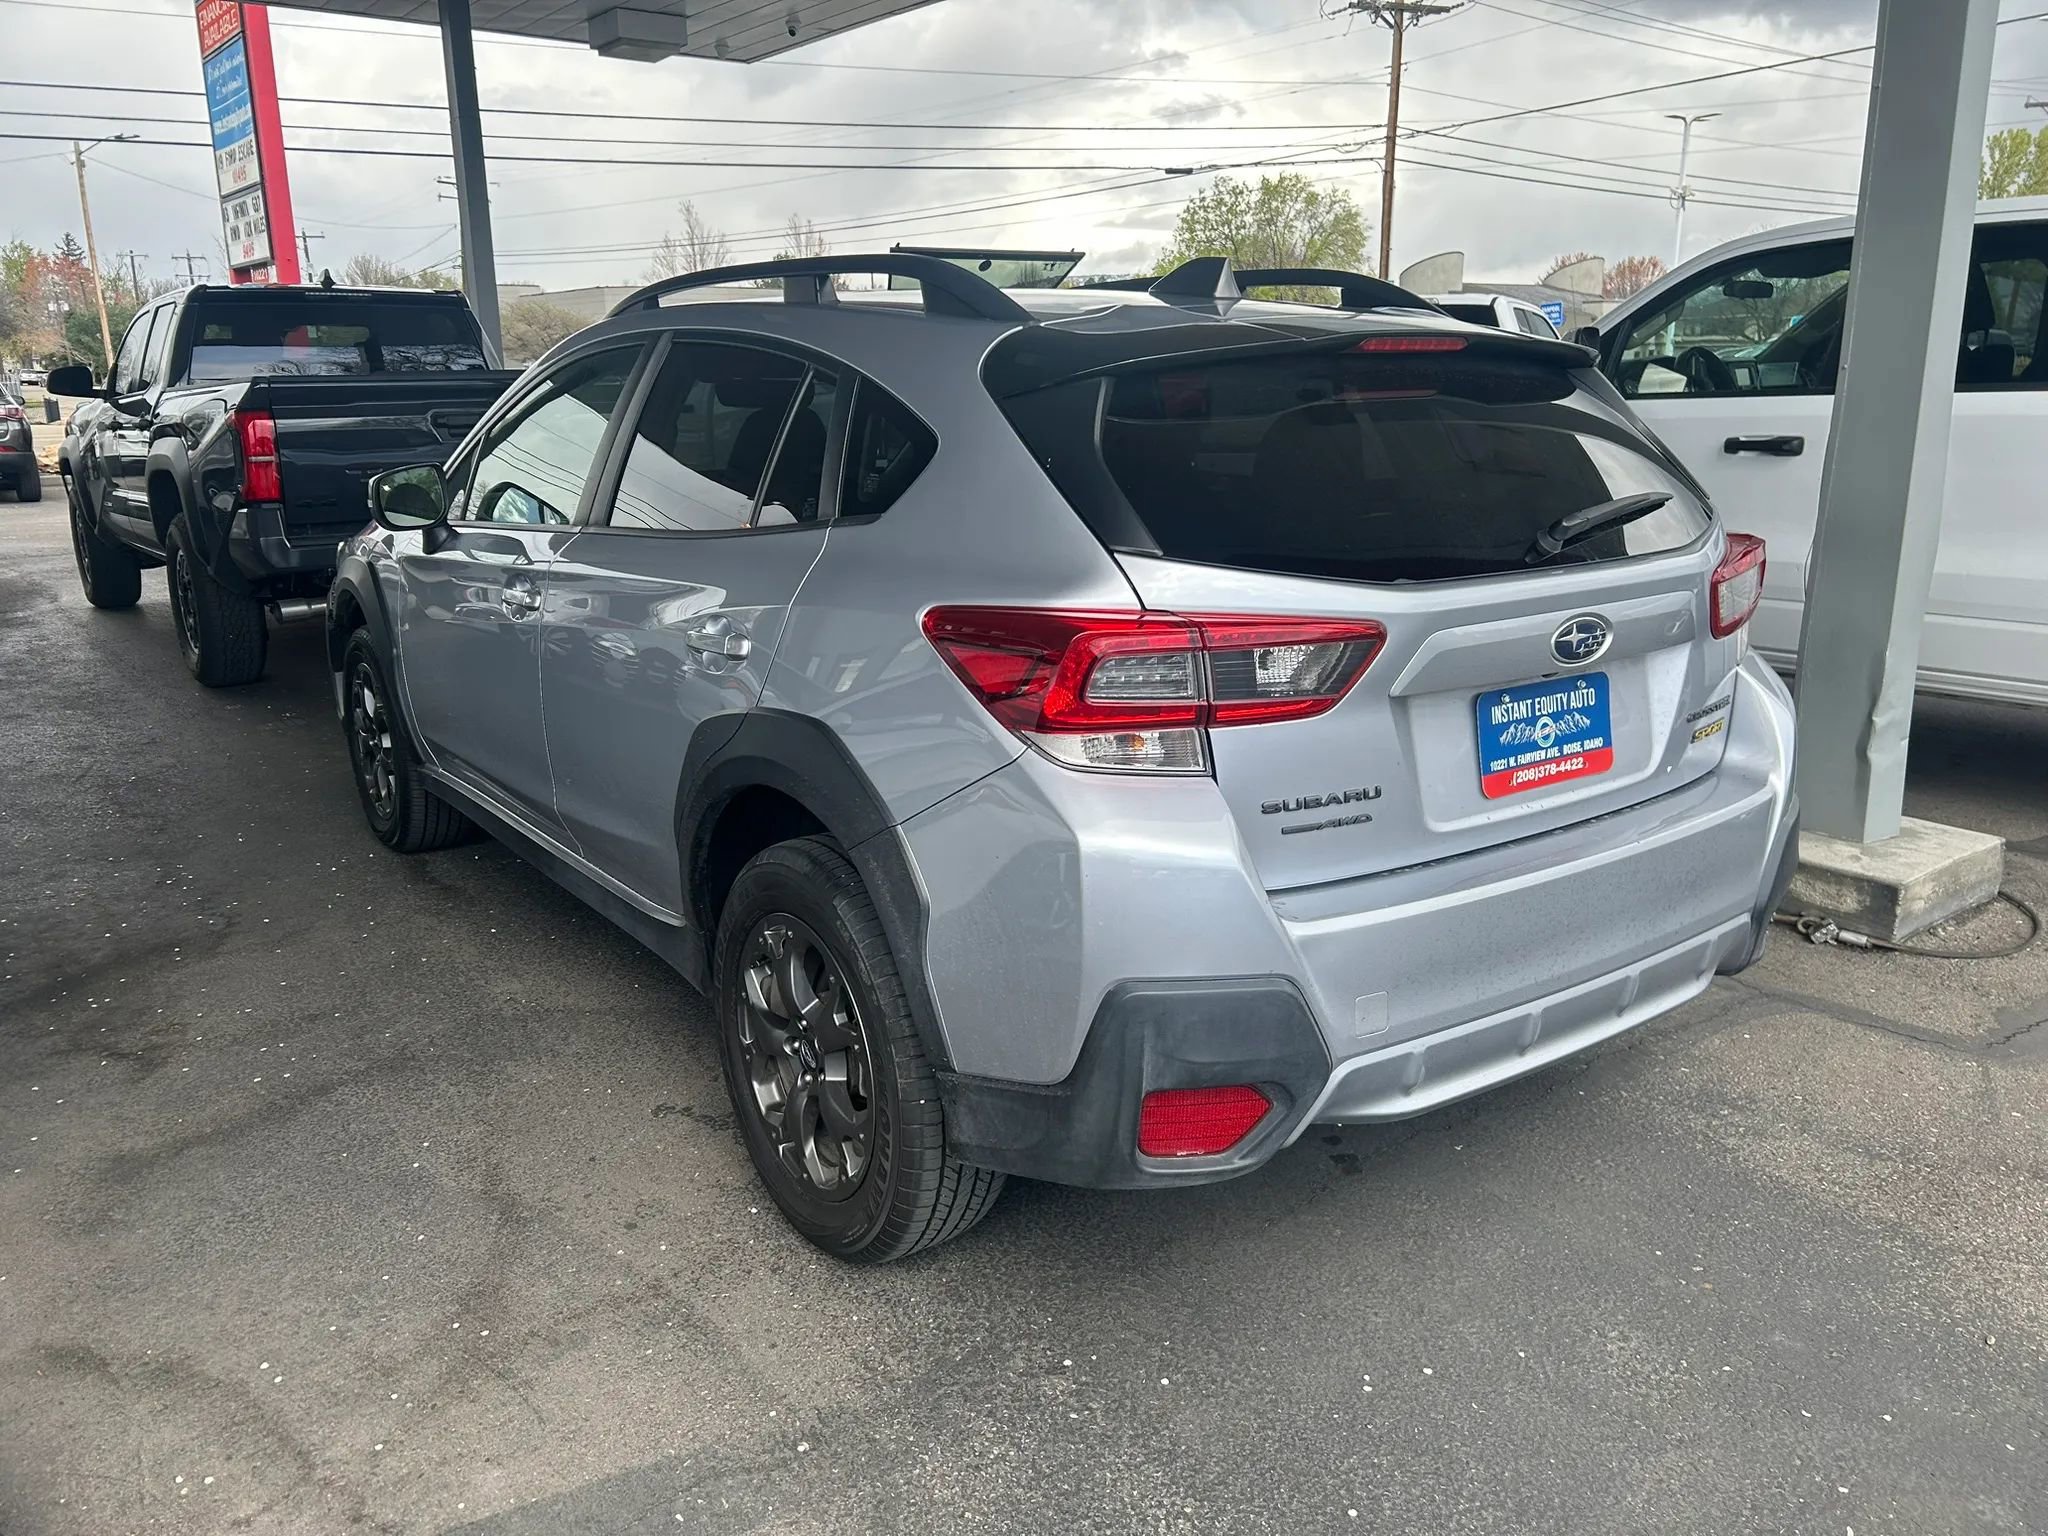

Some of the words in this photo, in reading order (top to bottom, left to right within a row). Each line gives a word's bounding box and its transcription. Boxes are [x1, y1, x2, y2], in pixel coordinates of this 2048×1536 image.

[203, 8, 238, 49] AVAILABLE
[237, 139, 254, 161] ESCAPE
[1491, 700, 1533, 725] INSTANT
[1534, 692, 1568, 715] EQUITY
[1570, 688, 1596, 709] AUTO
[1490, 757, 1508, 772] 10221
[1508, 756, 1517, 767] W.
[1517, 750, 1547, 766] FAIRVIEW
[1546, 747, 1561, 759] AVE.
[1563, 741, 1583, 755] BOISE,
[1583, 737, 1604, 751] IDAHO
[1512, 757, 1584, 786] (208)378-4422
[1261, 785, 1382, 814] SUBARU
